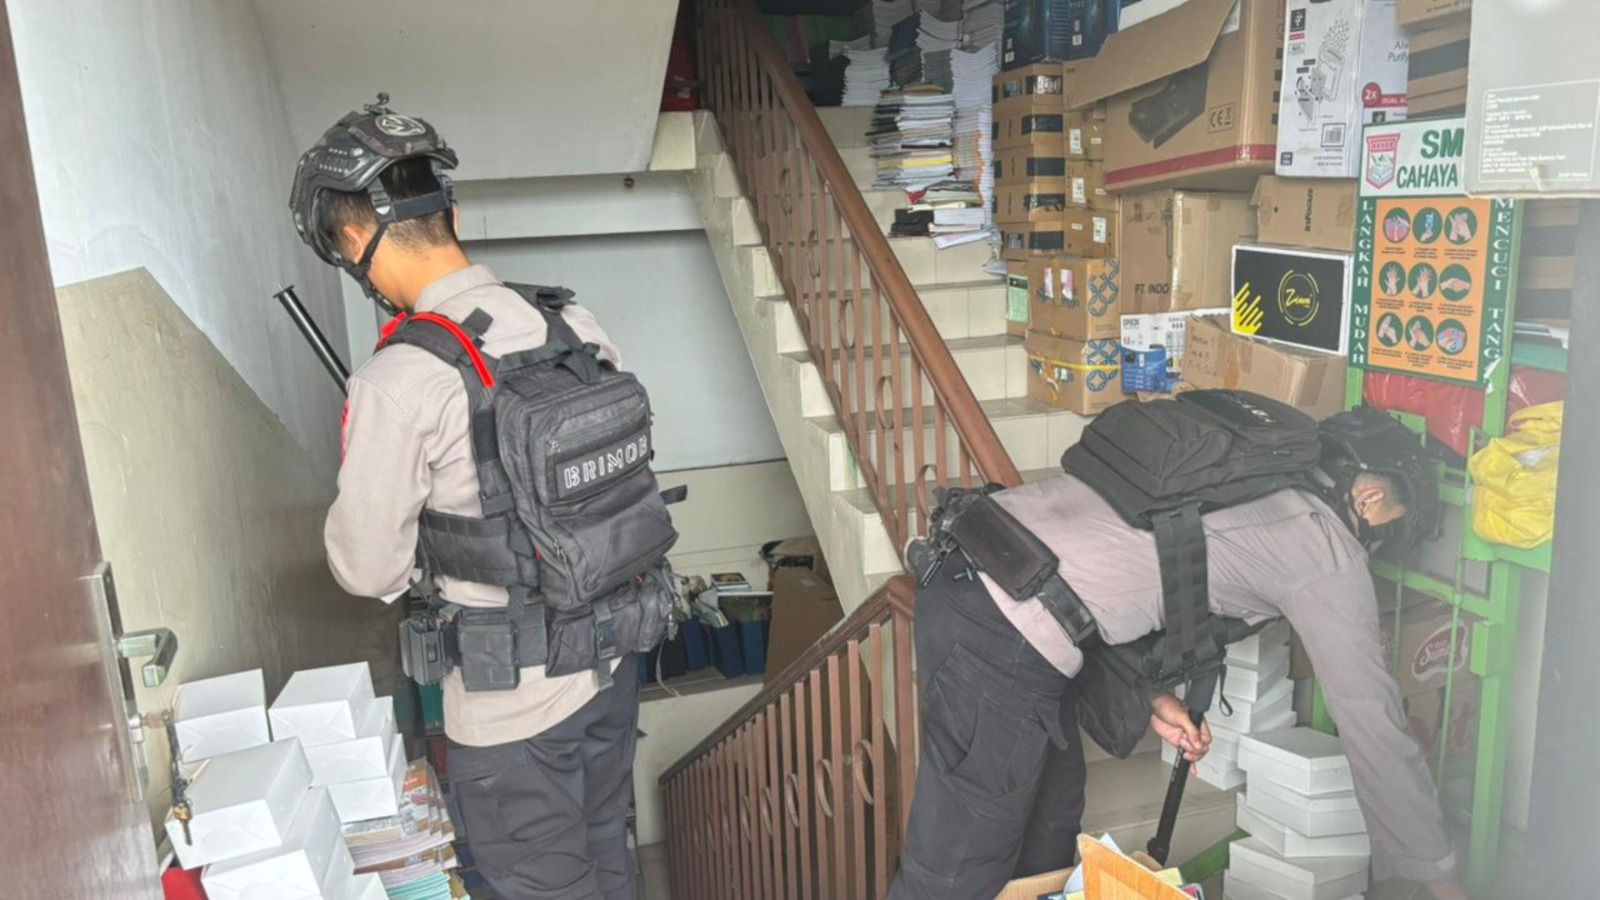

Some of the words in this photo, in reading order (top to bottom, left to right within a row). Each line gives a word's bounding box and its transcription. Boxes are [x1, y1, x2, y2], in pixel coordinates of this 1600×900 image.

[1396, 163, 1458, 188] CAHAYA
[1356, 201, 1374, 288] LANGKAH
[1491, 198, 1515, 291] MENCUCI
[1352, 303, 1370, 364] MUDAH
[563, 435, 648, 489] BRIMOB
